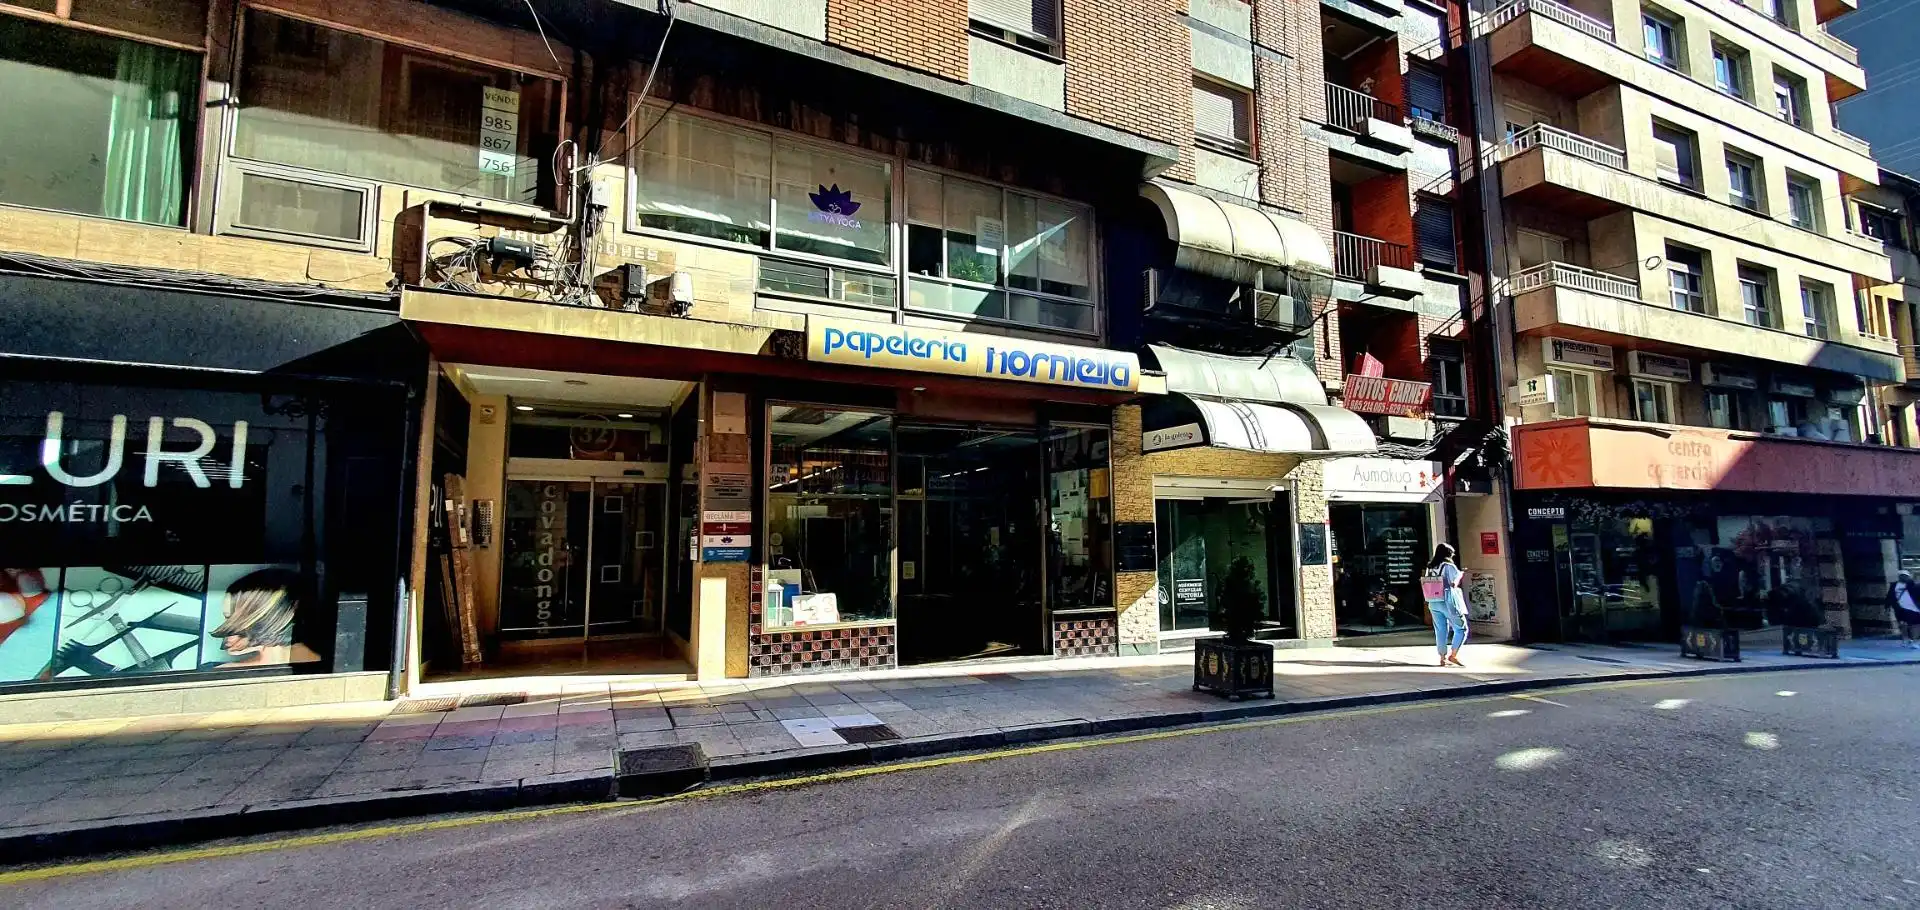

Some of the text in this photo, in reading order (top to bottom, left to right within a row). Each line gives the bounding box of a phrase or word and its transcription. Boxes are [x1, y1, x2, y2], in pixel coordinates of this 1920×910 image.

[484, 116, 512, 130] 985
[483, 136, 511, 151] 867
[483, 157, 510, 172] 756
[837, 218, 862, 229] YOGA
[1352, 377, 1388, 401] FOTOS
[1388, 381, 1430, 405] CARNET
[1362, 401, 1374, 412] 214
[579, 425, 608, 444] 32
[0, 411, 248, 489] URI
[1527, 507, 1565, 516] CONCEPTO
